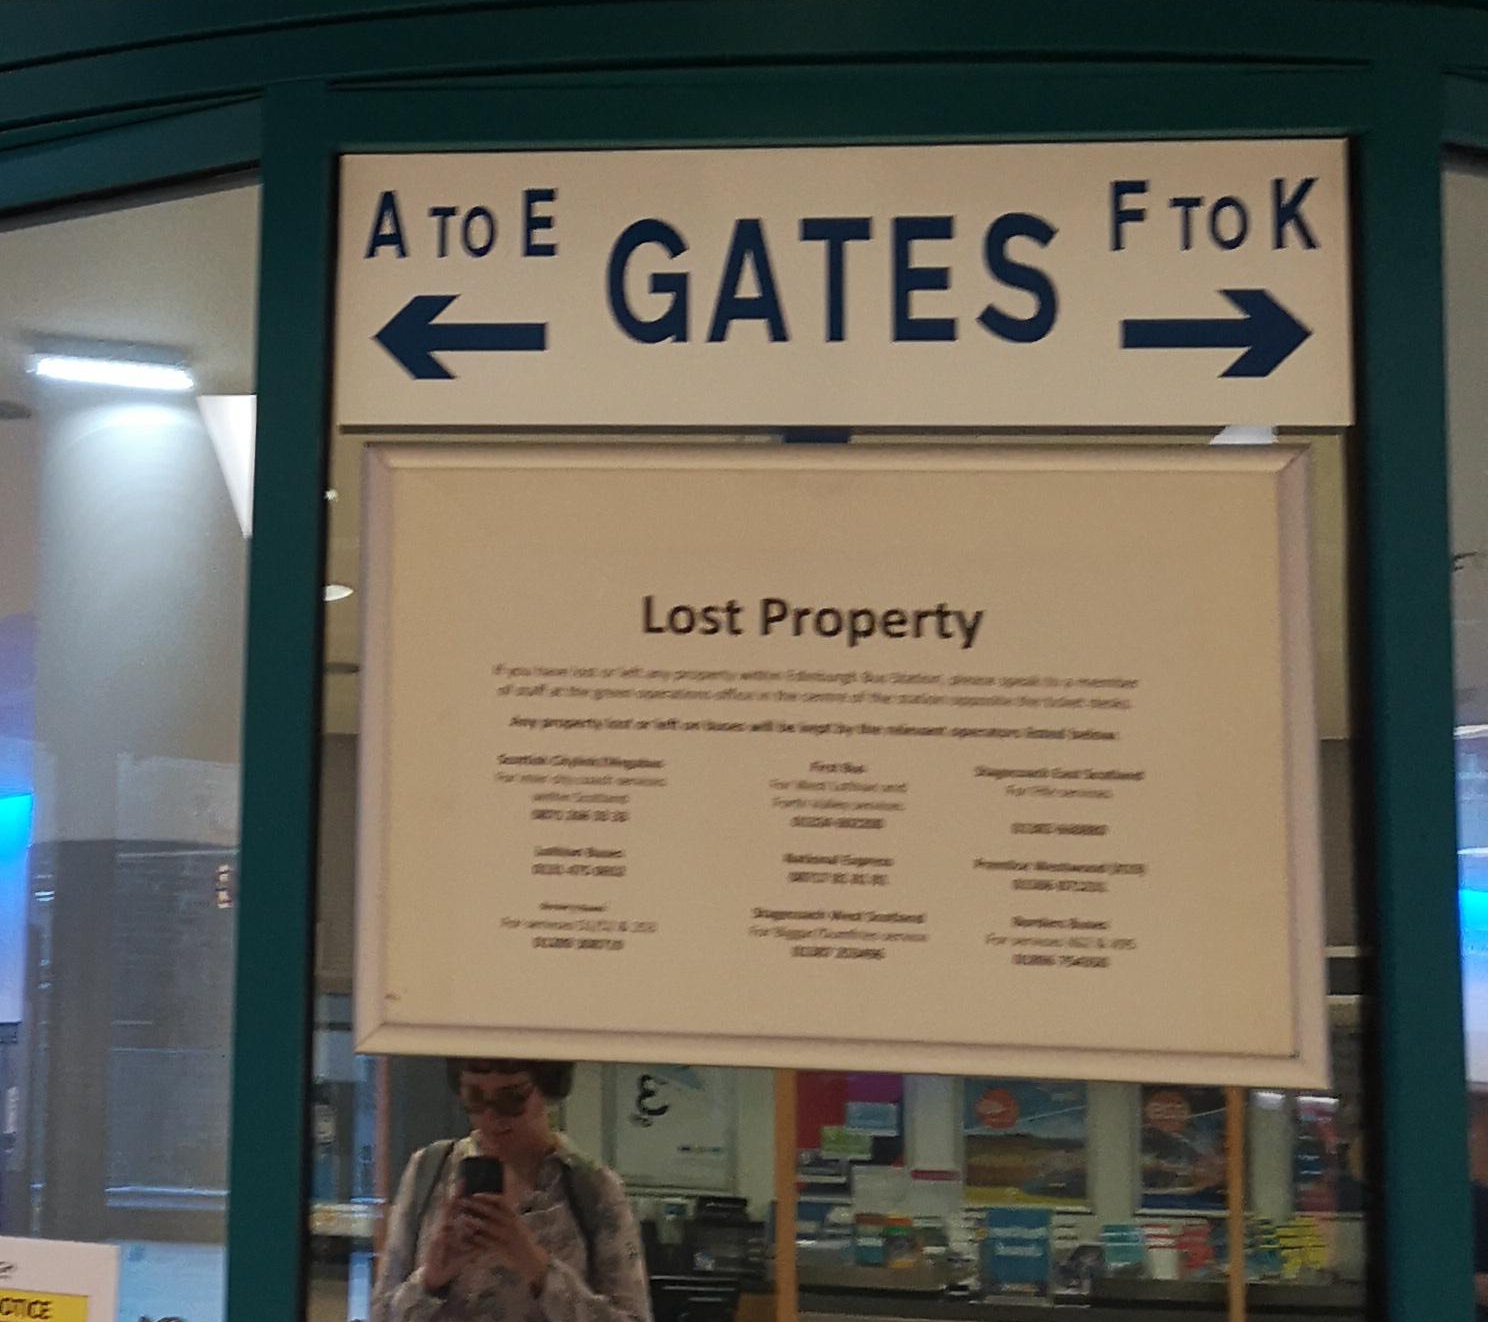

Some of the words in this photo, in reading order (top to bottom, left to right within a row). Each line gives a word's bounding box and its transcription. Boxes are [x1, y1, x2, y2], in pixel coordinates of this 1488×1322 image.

[365, 190, 407, 259] A
[520, 188, 560, 258] E
[1109, 181, 1150, 252] F
[1270, 176, 1320, 252] K
[606, 210, 1060, 345] GATES
[641, 594, 743, 637] Lost
[760, 598, 985, 649] Property
